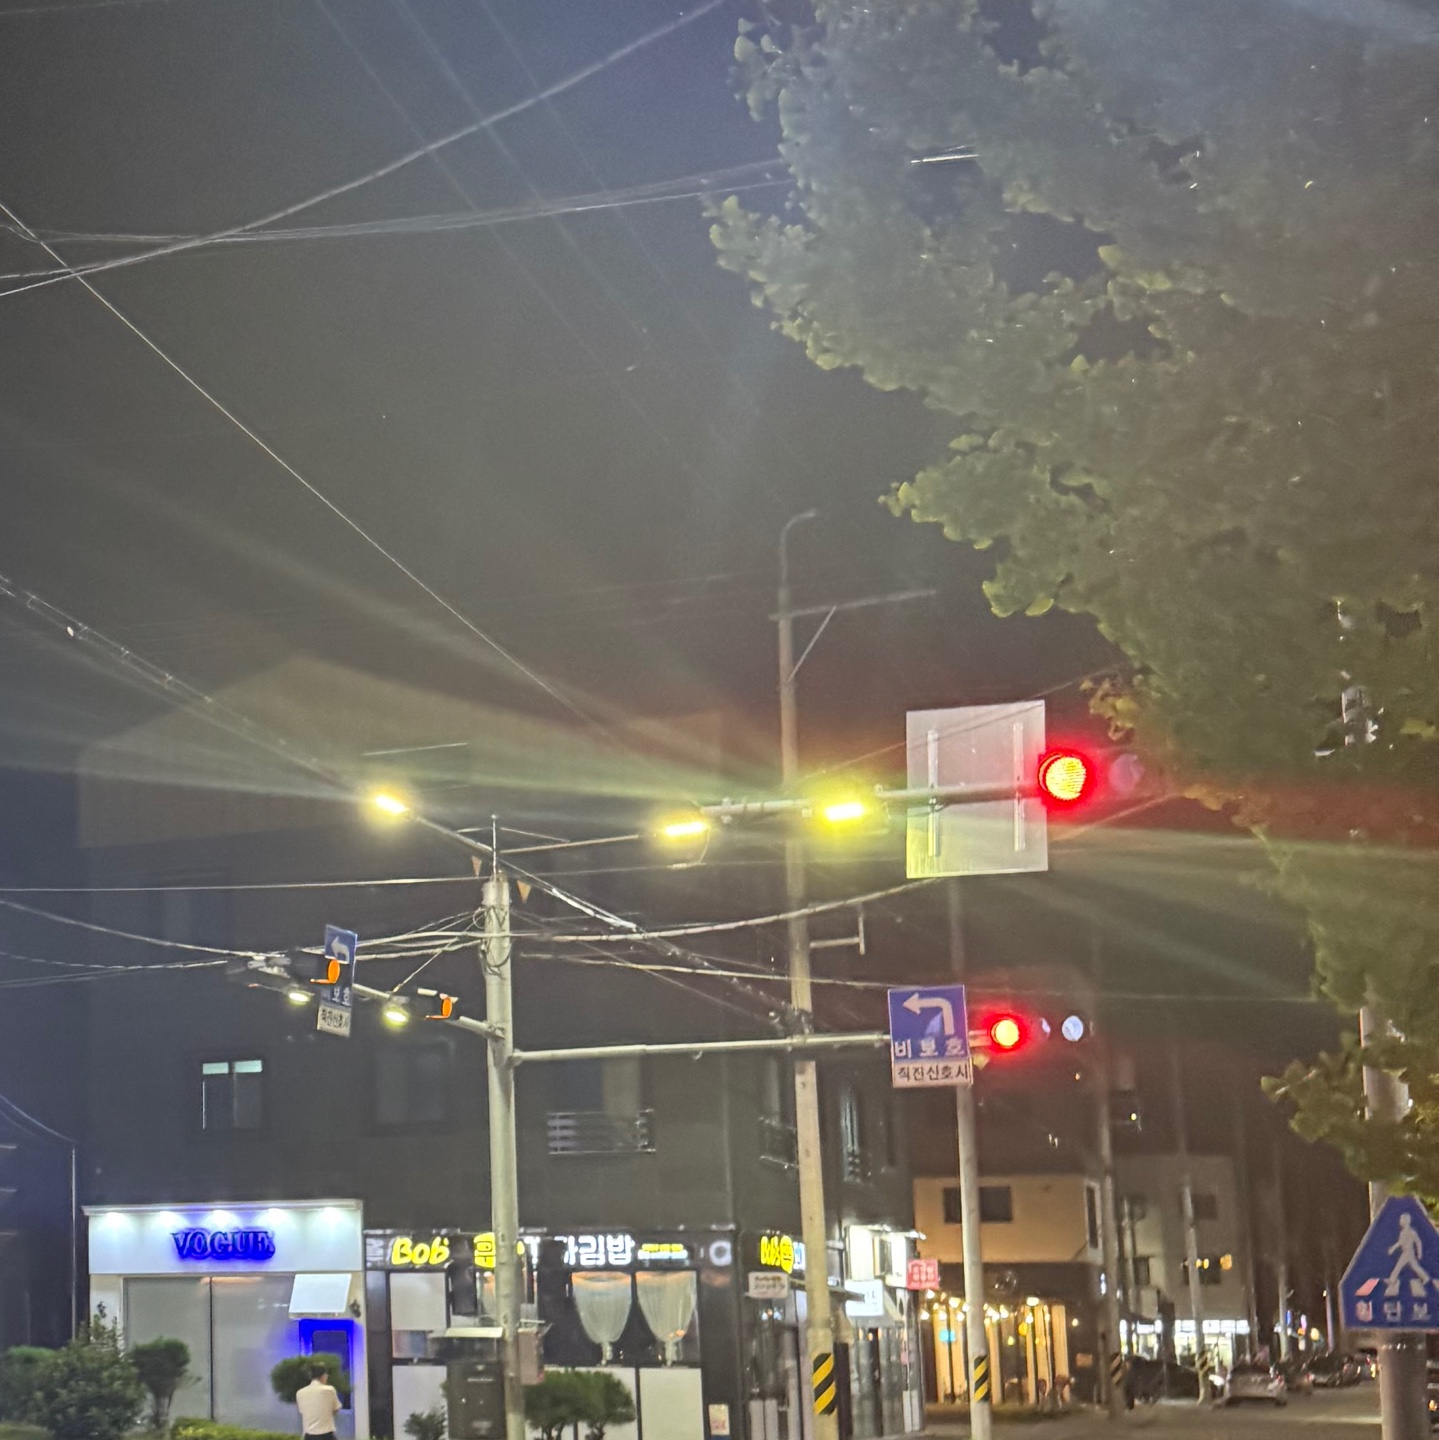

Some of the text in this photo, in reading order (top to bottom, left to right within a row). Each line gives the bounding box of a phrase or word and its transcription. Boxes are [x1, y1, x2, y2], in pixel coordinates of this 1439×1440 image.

[894, 1037, 965, 1058] 비보호
[898, 1064, 968, 1081] 직진신호시
[169, 1229, 276, 1260] VOGUE
